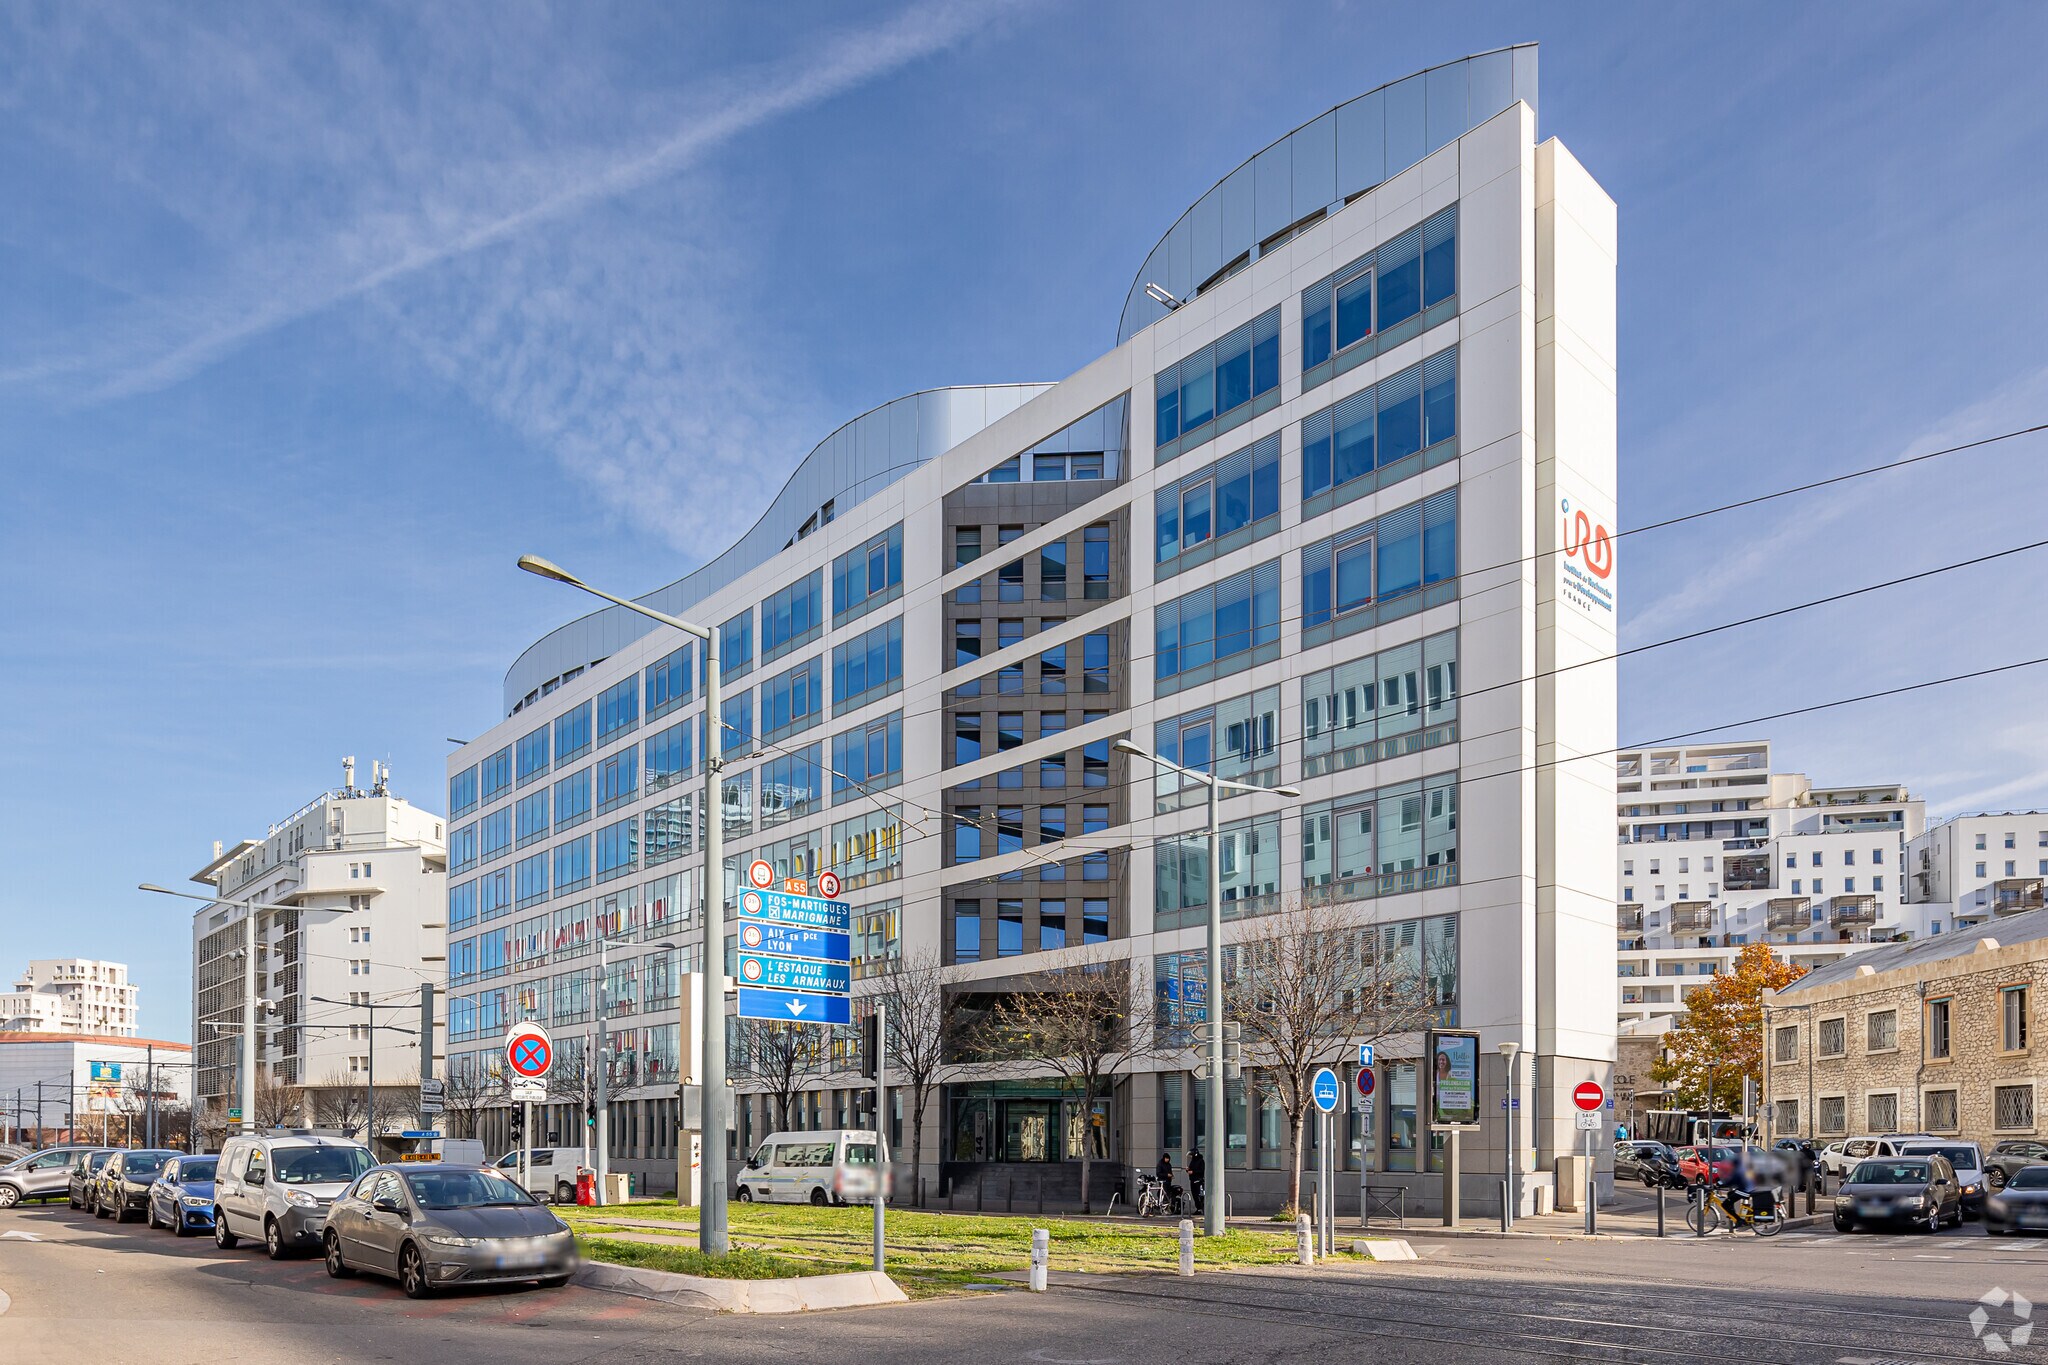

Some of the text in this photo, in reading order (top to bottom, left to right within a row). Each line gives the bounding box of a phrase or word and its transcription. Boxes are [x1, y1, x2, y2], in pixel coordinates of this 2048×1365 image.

[1563, 589, 1591, 611] FRANCE
[786, 882, 806, 893] A 55
[768, 894, 848, 915] FOS-MARTIGUES
[782, 909, 841, 926] MARIGNANE
[768, 928, 784, 940] AIX
[767, 940, 792, 952] LYON
[767, 960, 822, 976] L'ESTAQUE
[767, 972, 846, 989] LES ARNAVAUX
